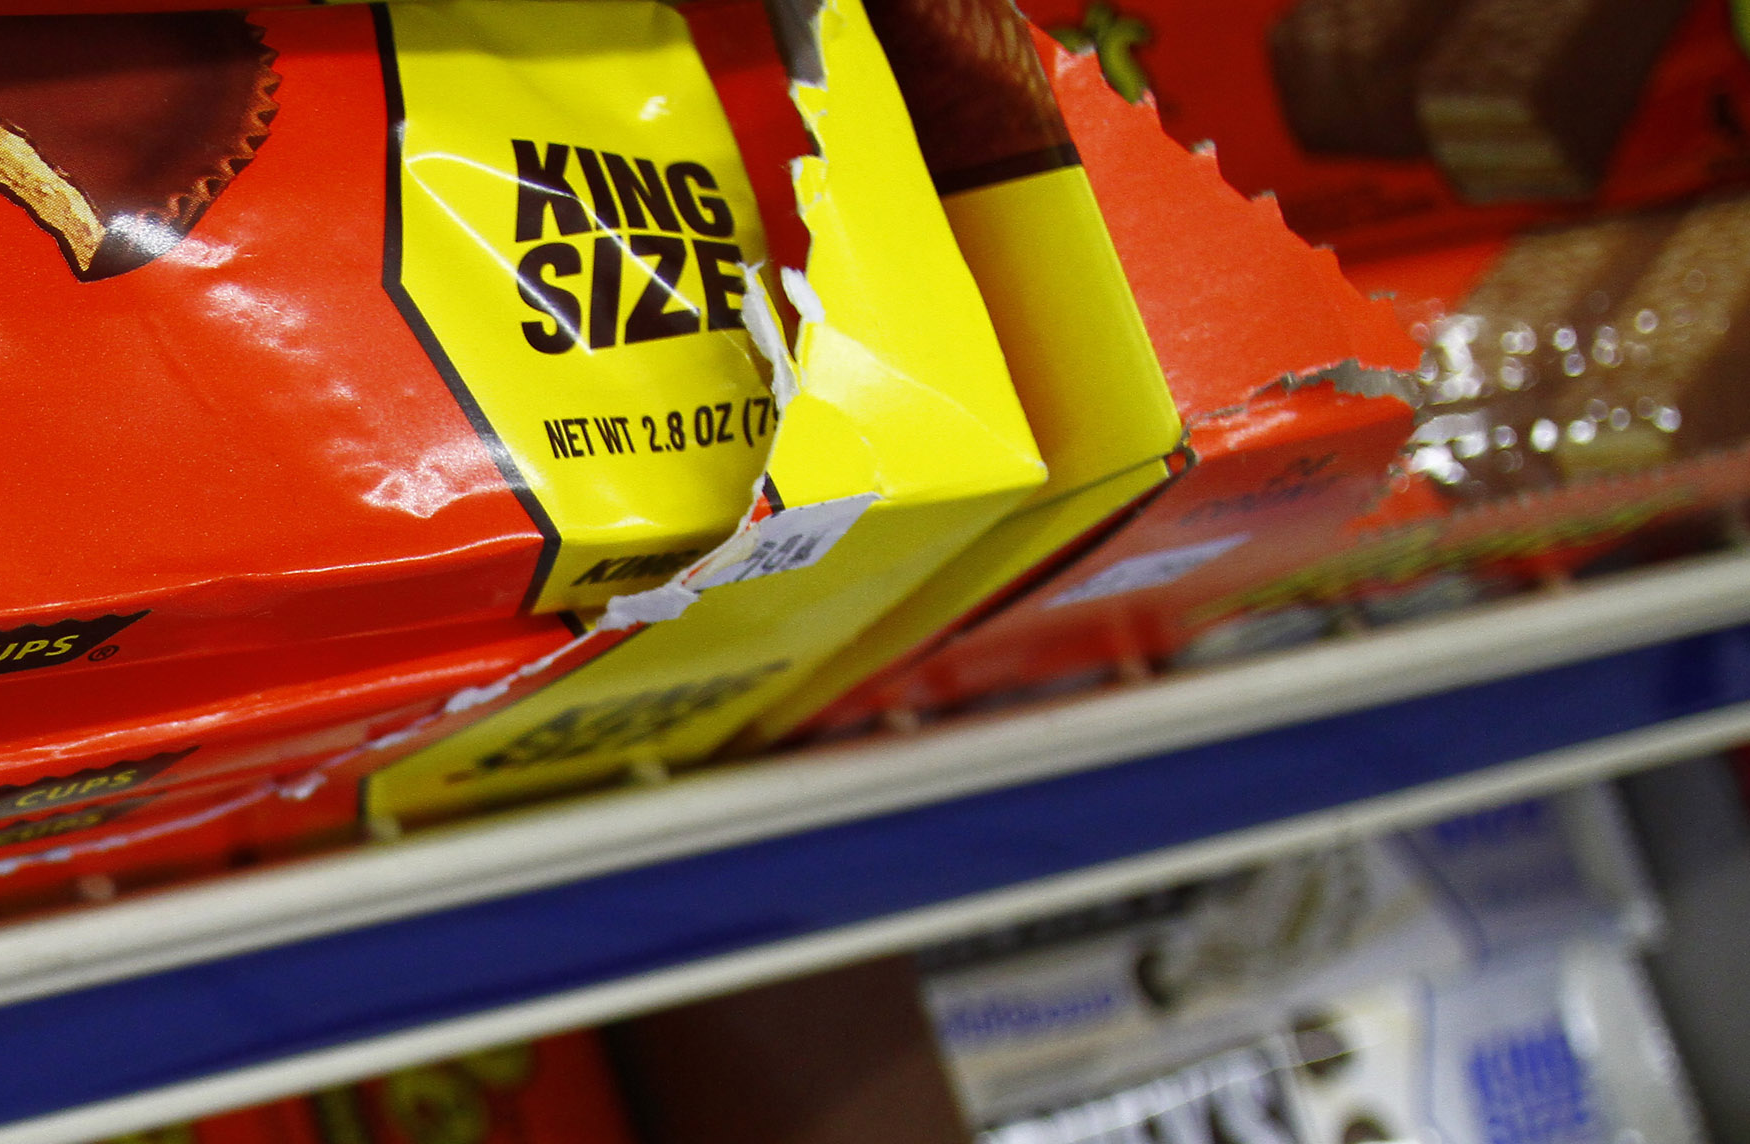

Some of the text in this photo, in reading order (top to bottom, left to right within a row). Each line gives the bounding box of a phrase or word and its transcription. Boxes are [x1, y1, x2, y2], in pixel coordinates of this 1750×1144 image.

[511, 139, 735, 242] KING
[516, 235, 746, 355] SIZE
[544, 417, 594, 459] NET
[594, 416, 636, 454] WT
[642, 410, 686, 453] 2.8
[694, 402, 734, 447] OZ
[15, 769, 138, 808] CUPS
